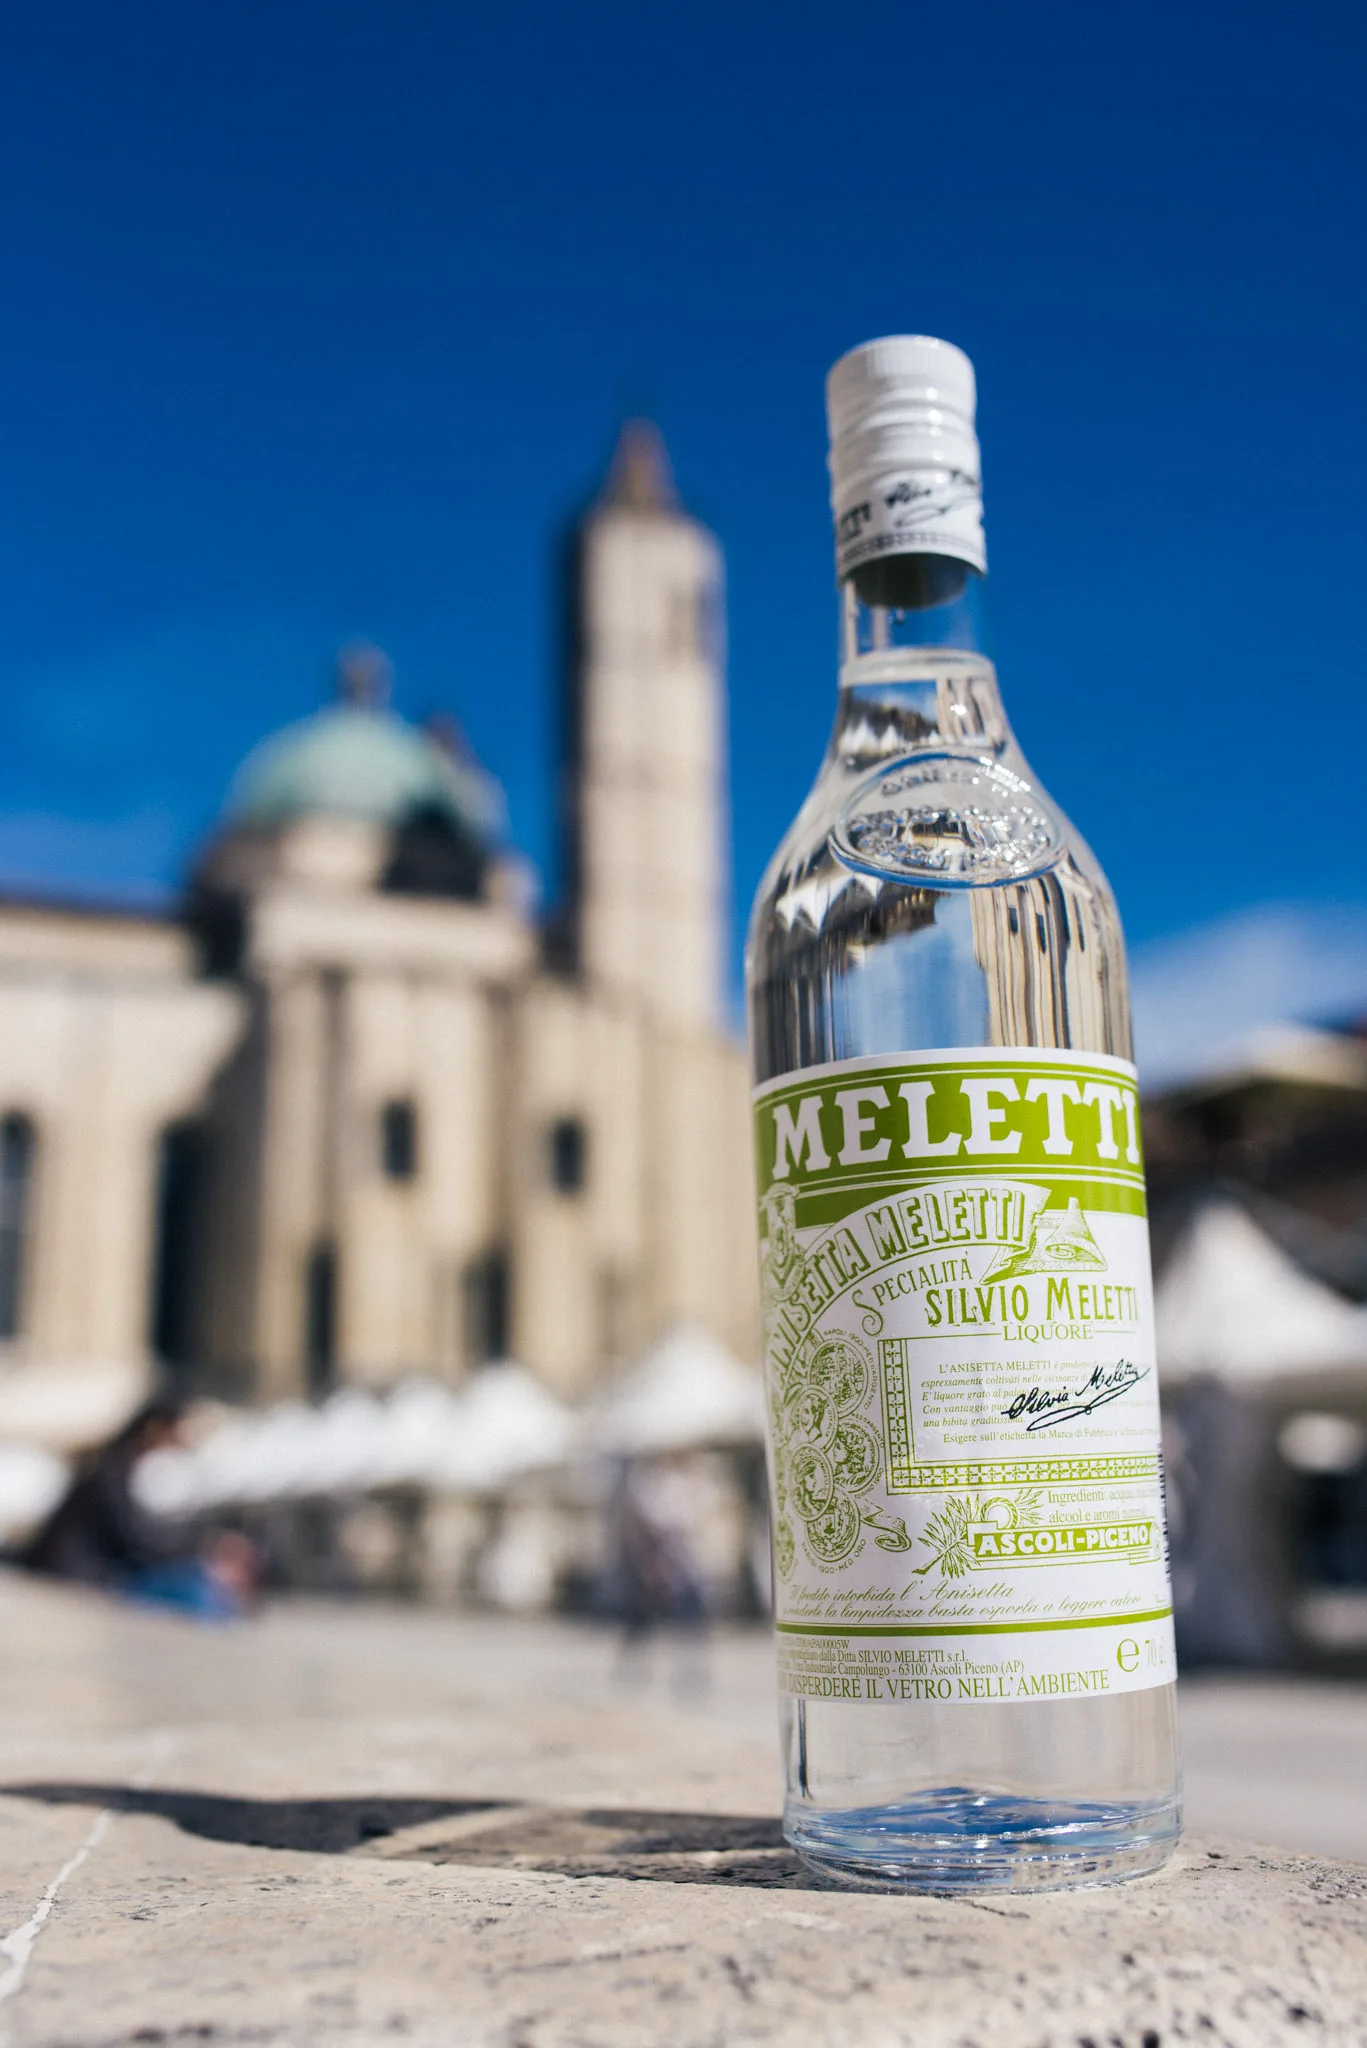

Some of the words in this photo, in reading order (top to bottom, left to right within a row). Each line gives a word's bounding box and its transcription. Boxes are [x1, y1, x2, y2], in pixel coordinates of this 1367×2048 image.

[772, 1078, 1140, 1181] MELETTI
[770, 1227, 872, 1388] NISETTA
[865, 1188, 1026, 1262] MELETTI
[925, 1284, 1030, 1328] SILVIO
[1046, 1276, 1138, 1323] MELETTI
[1003, 1323, 1094, 1344] LIQUORE
[939, 1361, 1003, 1374] L'ANISETTA
[1006, 1360, 1051, 1371] MELETTI
[920, 1377, 983, 1390] espressamente
[985, 1375, 1021, 1385] coltivati
[933, 1390, 965, 1402] liquore
[967, 1391, 990, 1402] grato
[992, 1387, 1001, 1398] al
[922, 1404, 941, 1415] Con
[943, 1403, 989, 1416] vantaggio
[923, 1418, 940, 1428] una
[941, 1416, 968, 1427] bibita
[943, 1432, 977, 1445] Esigere
[979, 1429, 1037, 1441] sull'etichetta
[1038, 1429, 1046, 1439] la
[1048, 1429, 1074, 1440] Marca
[1049, 1509, 1083, 1525] alcool
[1084, 1512, 1091, 1523] e
[978, 1524, 1149, 1556] ASCOLI-PICENO
[832, 1585, 897, 1602] intorbida
[824, 1603, 839, 1618] la
[840, 1602, 925, 1625] limpidezza
[927, 1602, 976, 1618] basta
[837, 1650, 857, 1663] Ditta
[858, 1650, 892, 1663] SILVIO
[894, 1649, 945, 1663] MELETTI
[838, 1662, 890, 1679] Campolungo
[898, 1662, 928, 1676] 63100
[930, 1660, 962, 1675] Ascoli
[965, 1660, 999, 1675] Piceno
[1000, 1659, 1025, 1676] (AP)
[865, 1678, 883, 1699] IL
[887, 1678, 952, 1700] VETRO
[957, 1669, 1110, 1699] NELL'AMBIENTE
